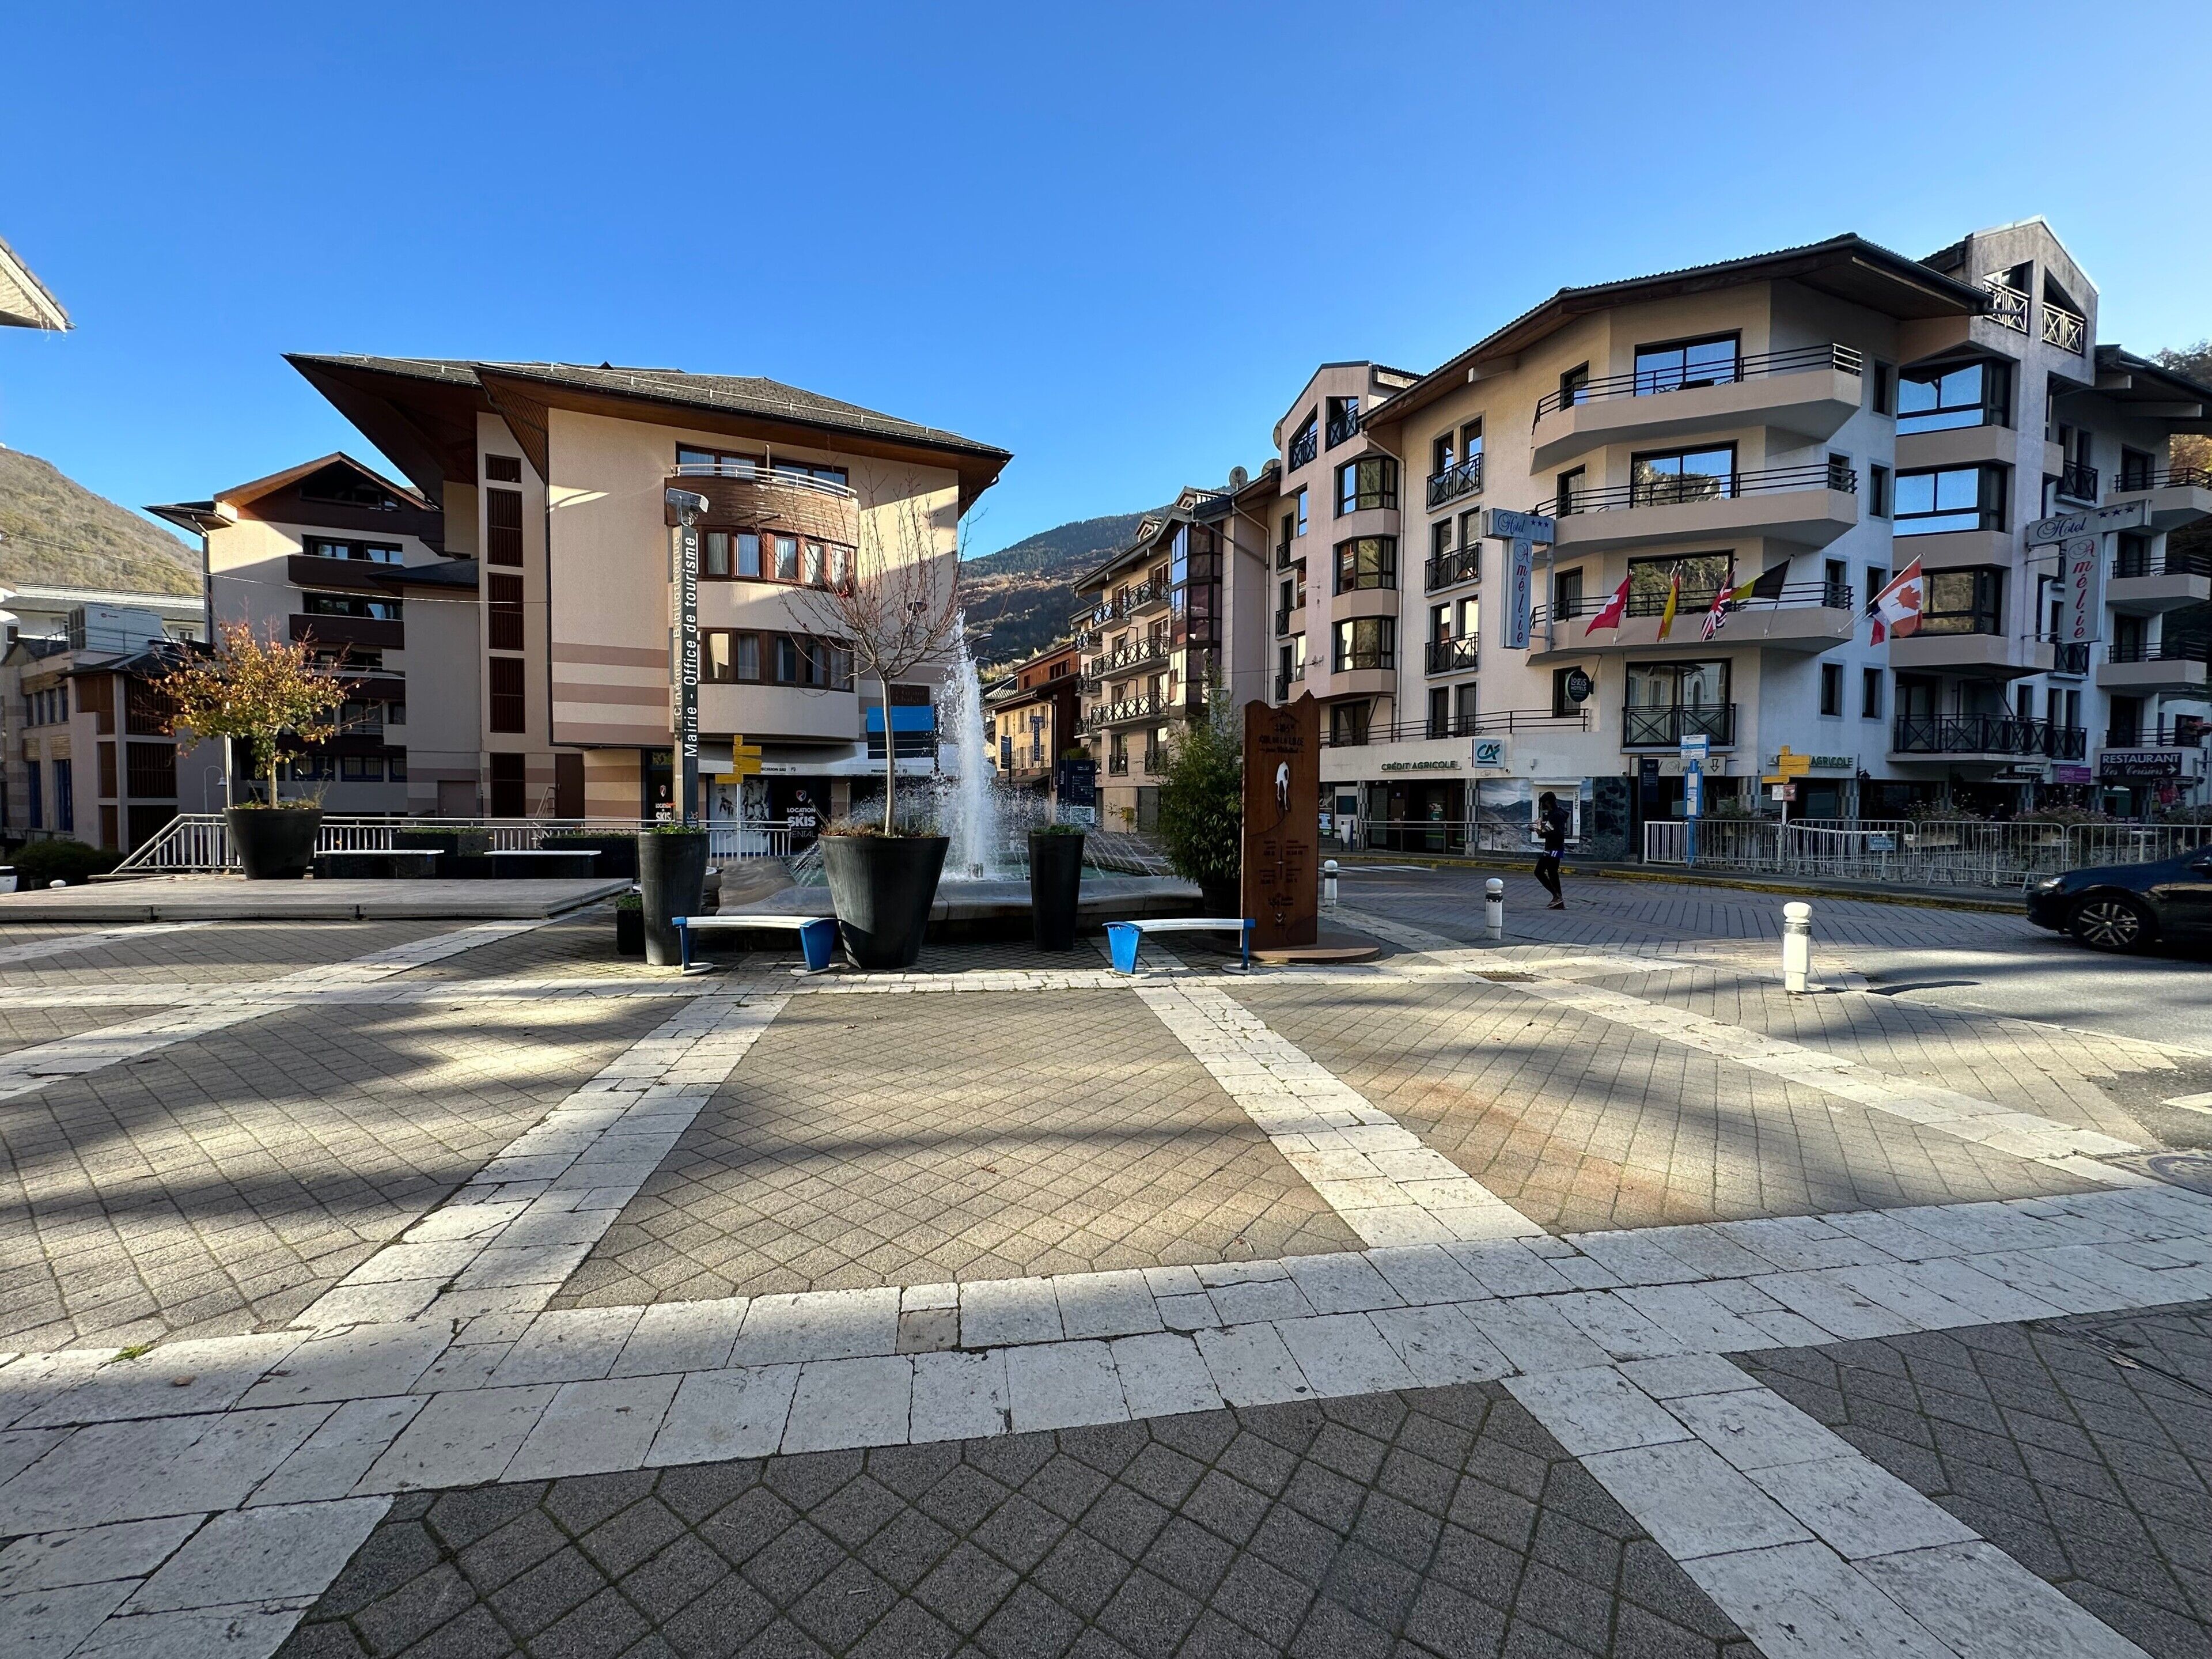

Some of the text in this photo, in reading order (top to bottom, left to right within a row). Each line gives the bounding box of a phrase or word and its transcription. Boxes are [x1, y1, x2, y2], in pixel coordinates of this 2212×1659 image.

[1498, 513, 1525, 535] Hotel
[2037, 517, 2087, 539] Hotel
[683, 537, 696, 607] tourisme
[673, 536, 681, 638] Bibliothèque
[1514, 543, 1531, 643] Amélie
[2068, 539, 2097, 638] Amélie
[683, 614, 696, 632] de
[683, 640, 697, 685] Office
[684, 707, 697, 757] Mairie
[1381, 760, 1456, 770] CRÉDIT AGRICOLE
[1810, 756, 1853, 766] AGRICOLE
[2103, 754, 2180, 763] RESTAURANT
[2101, 765, 2118, 775] Les
[787, 816, 816, 827] SKIS
